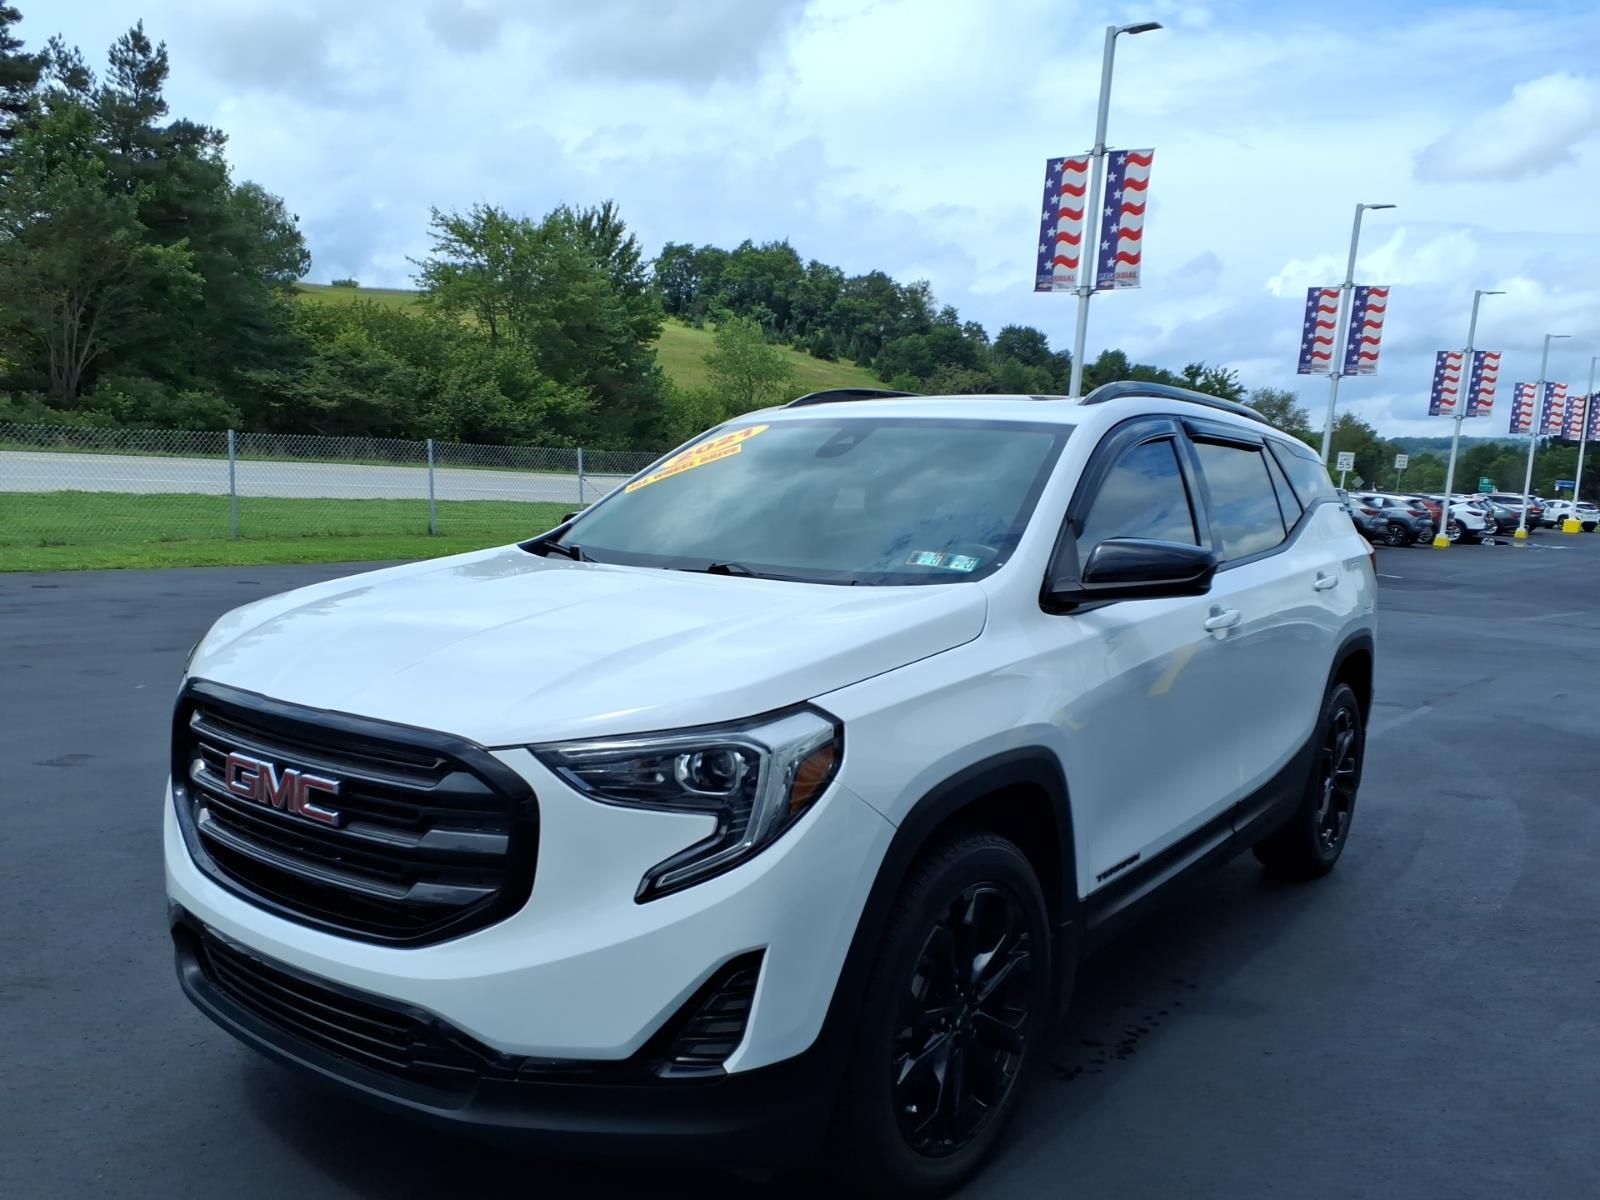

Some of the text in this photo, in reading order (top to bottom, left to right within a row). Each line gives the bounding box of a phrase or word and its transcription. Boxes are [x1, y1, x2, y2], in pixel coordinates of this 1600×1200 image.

[673, 428, 755, 463] 2021
[1338, 461, 1352, 469] 55
[226, 752, 339, 827] GMC
